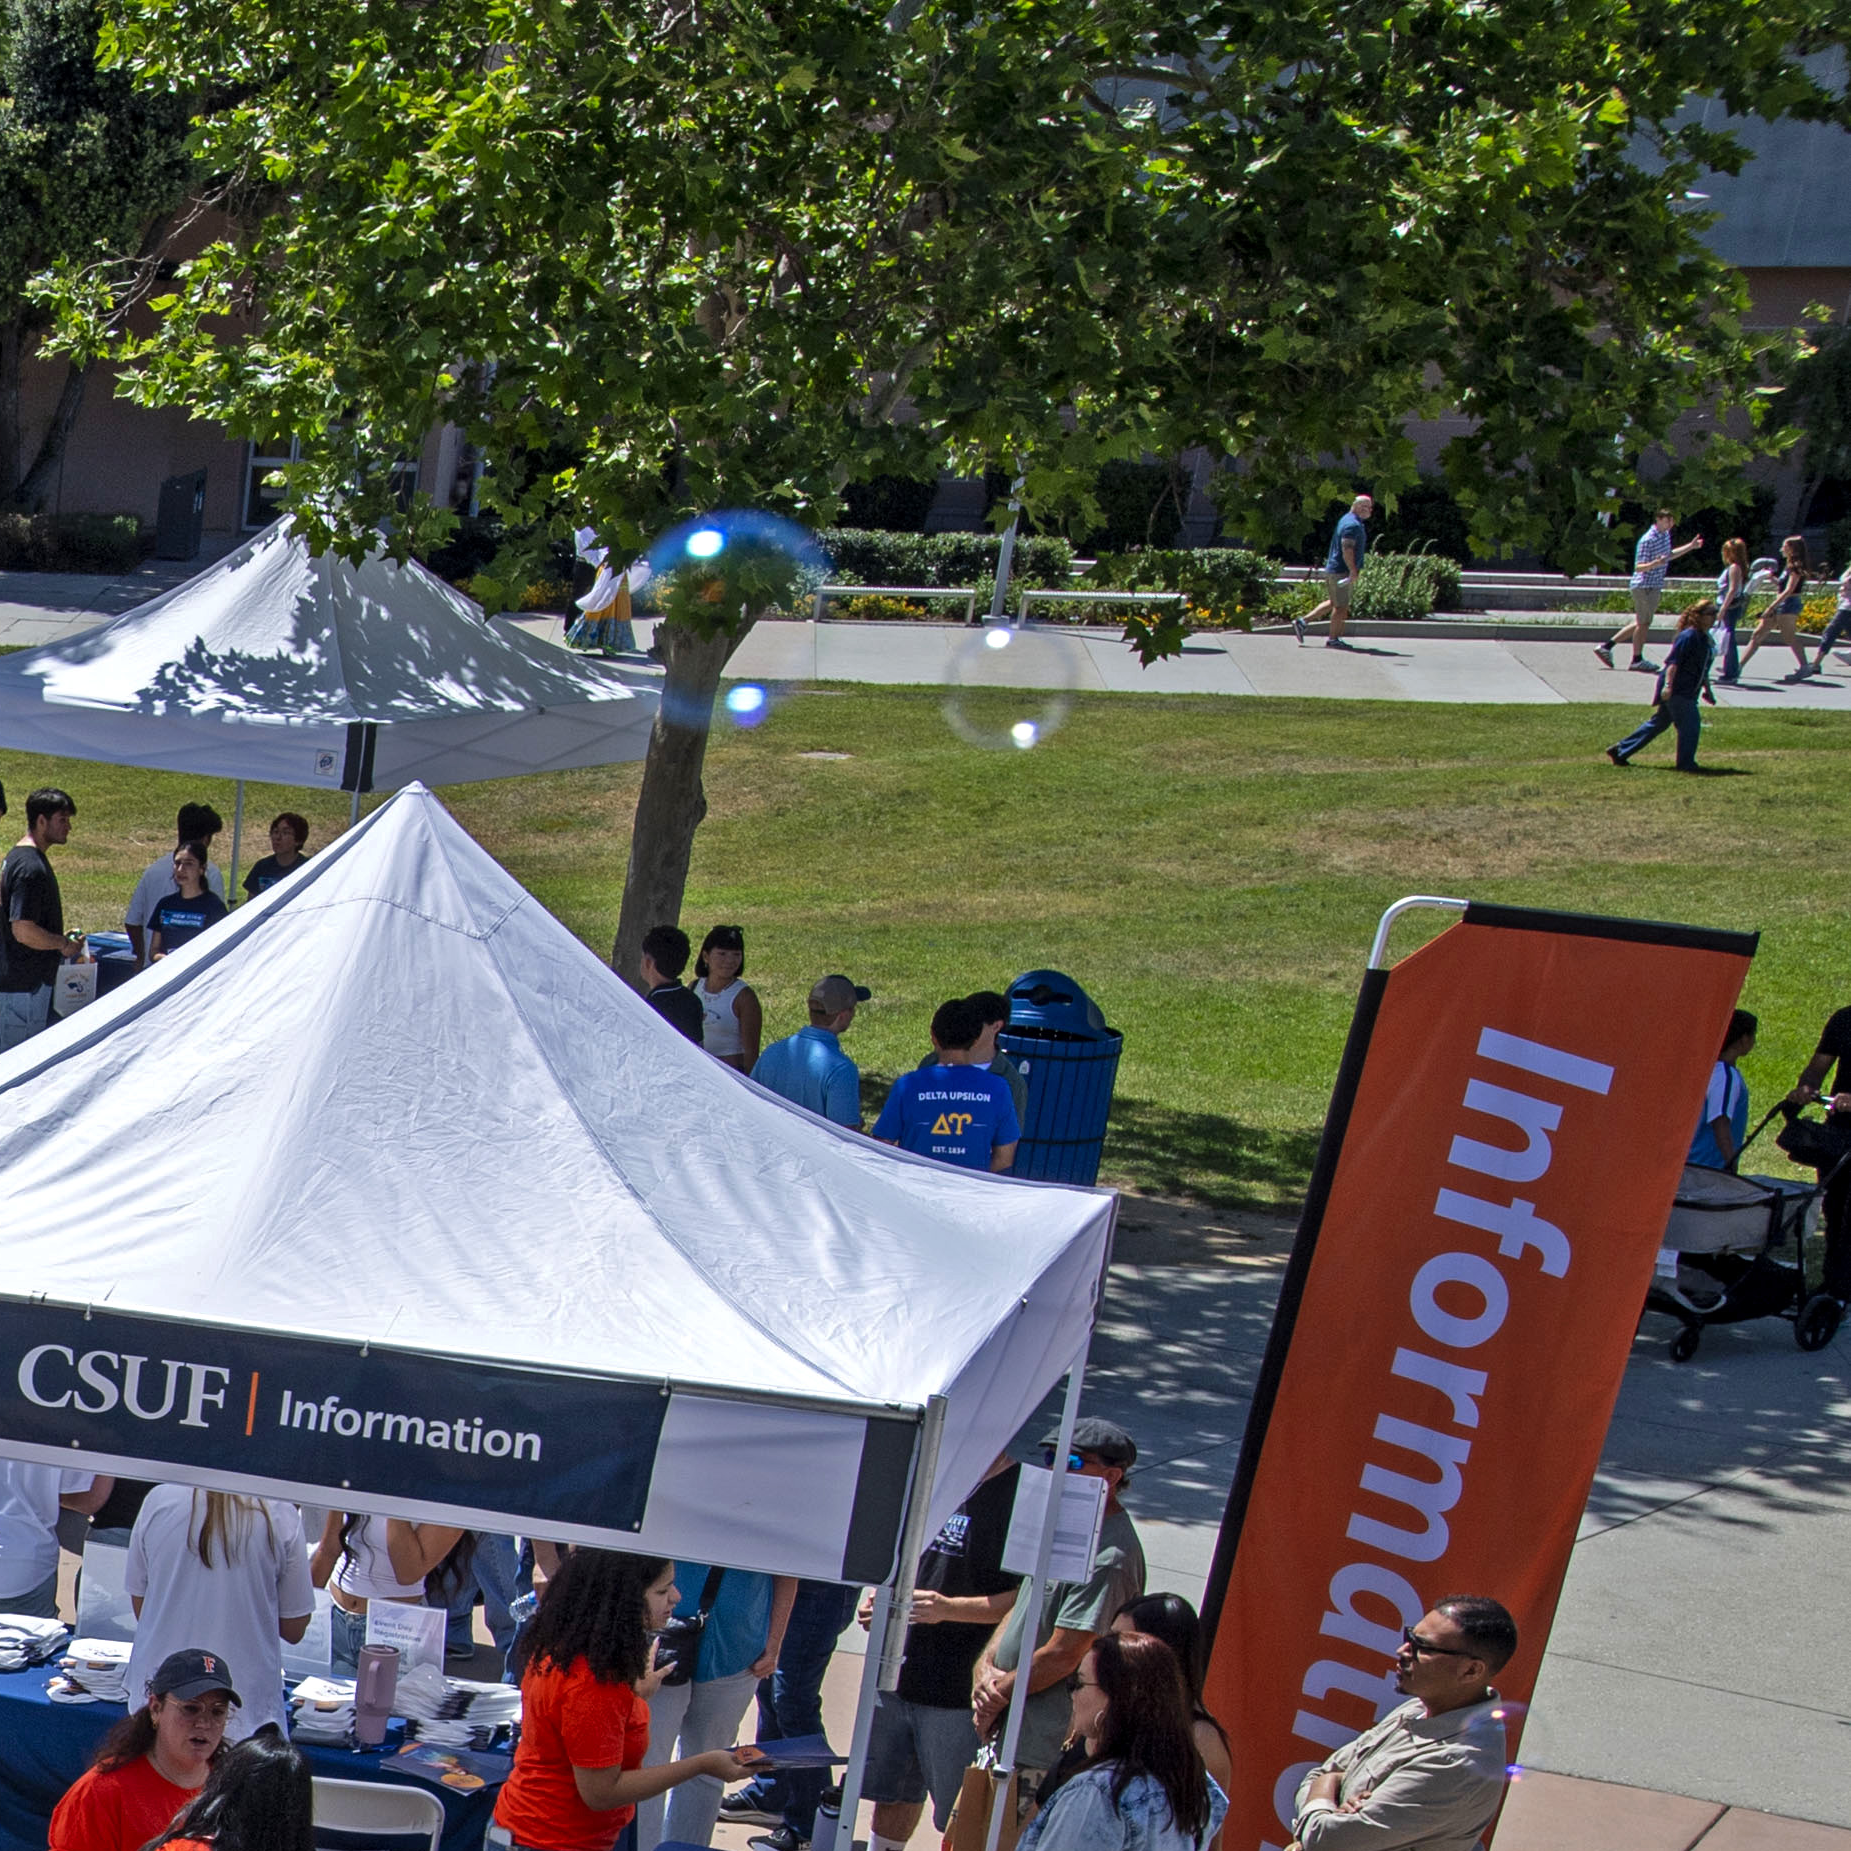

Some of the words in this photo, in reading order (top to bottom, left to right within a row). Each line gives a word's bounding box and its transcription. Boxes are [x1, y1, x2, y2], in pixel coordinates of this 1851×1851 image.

[918, 1091, 948, 1101] DELTA
[949, 1091, 991, 1102] UPSILON
[948, 1146, 966, 1154] 1834
[17, 1344, 230, 1428] CSUF
[279, 1390, 543, 1463] Information
[202, 1655, 216, 1673] F
